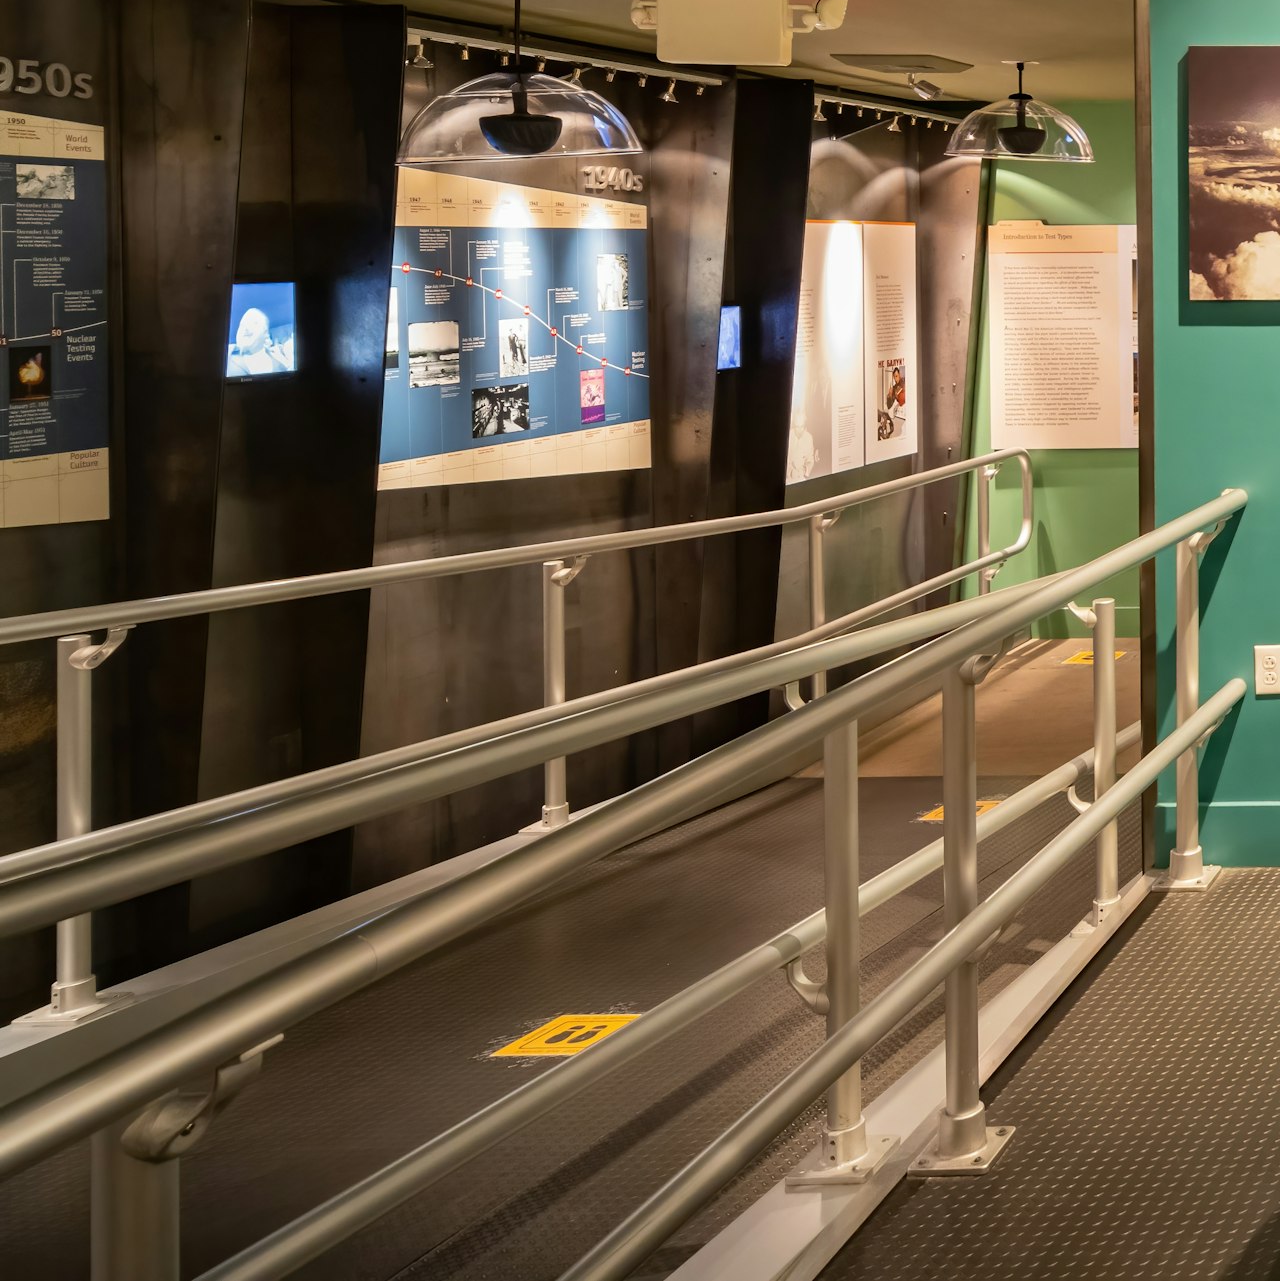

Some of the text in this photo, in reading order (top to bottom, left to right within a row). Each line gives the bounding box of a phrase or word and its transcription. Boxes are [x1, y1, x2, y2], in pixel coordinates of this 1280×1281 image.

[66, 134, 88, 142] World
[66, 144, 92, 152] Events
[581, 165, 643, 192] 1940s
[67, 354, 93, 362] Events
[70, 451, 99, 460] Popular
[70, 460, 98, 469] Culture
